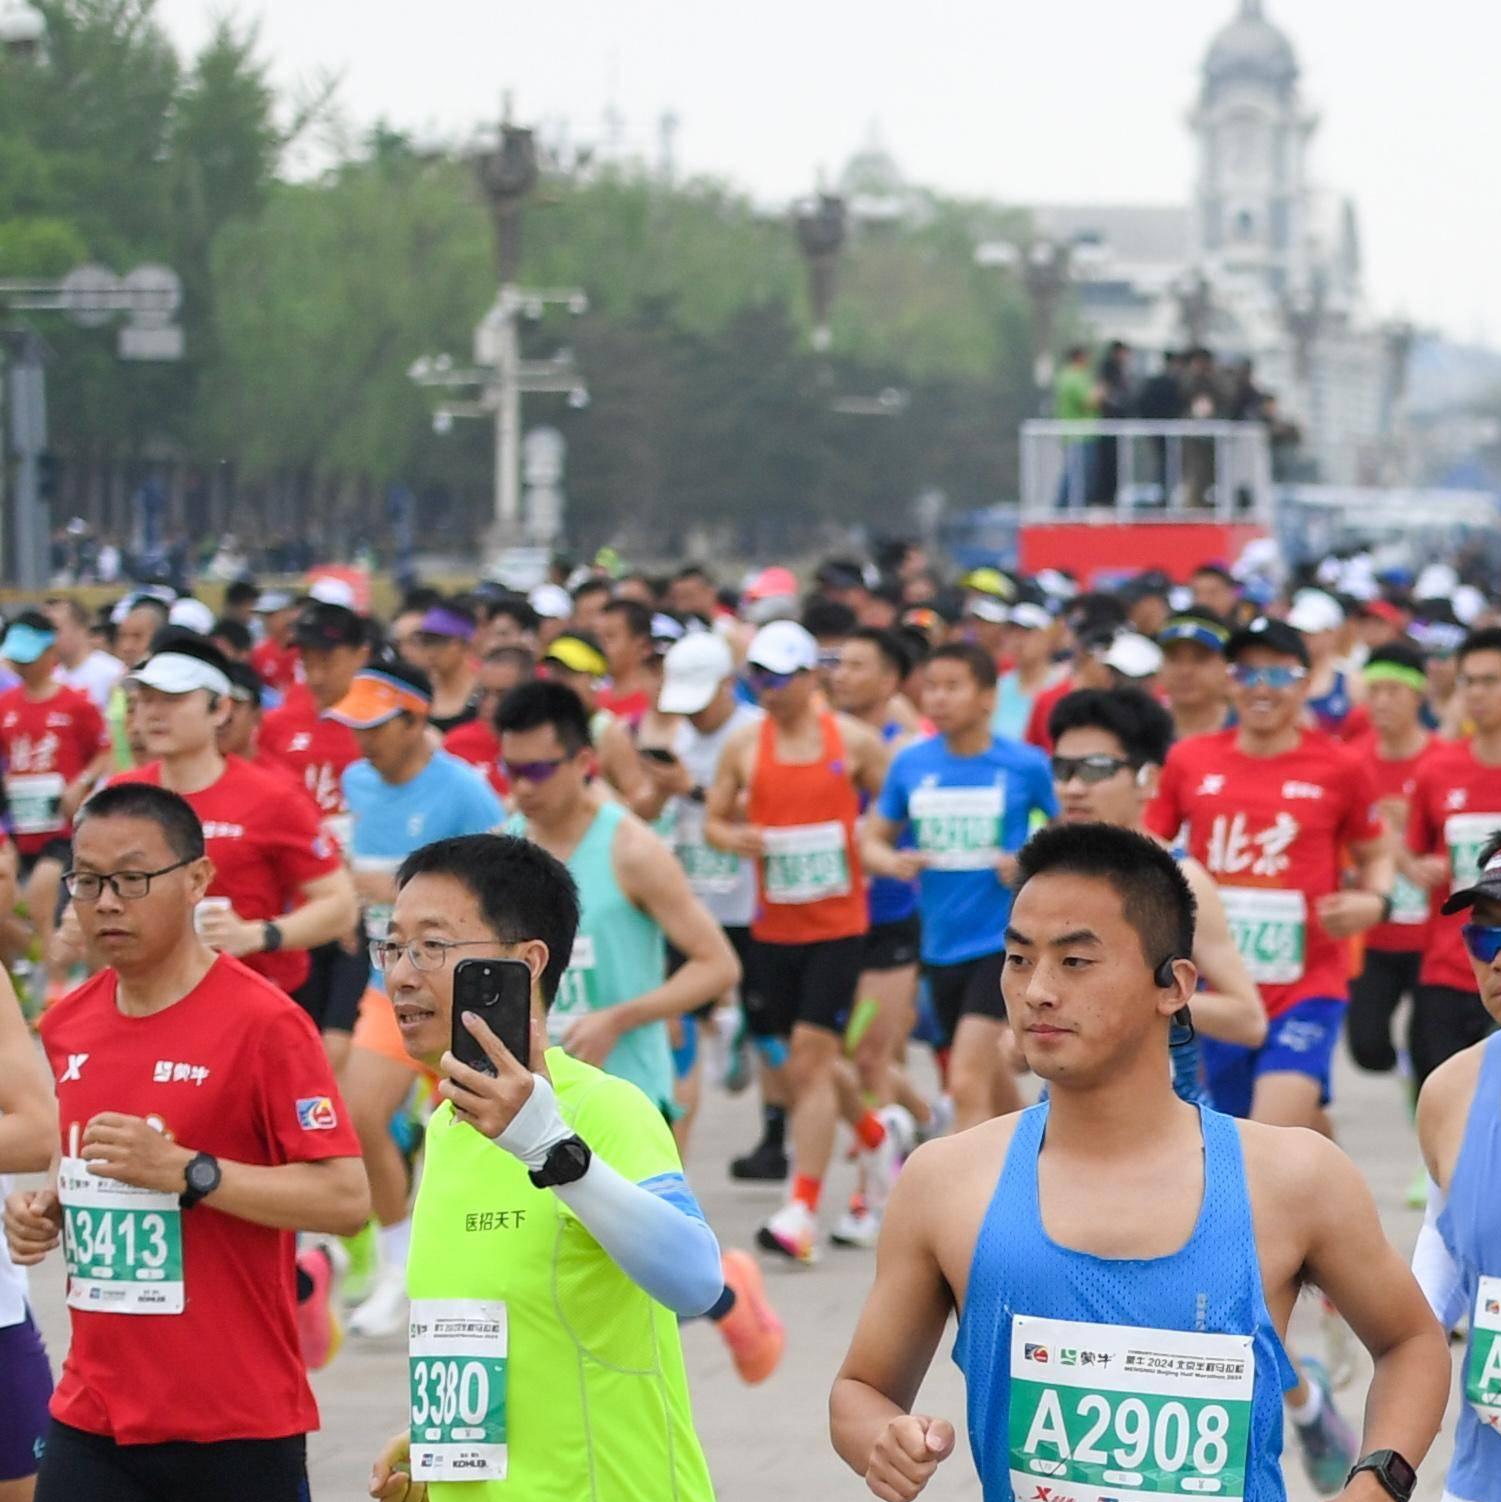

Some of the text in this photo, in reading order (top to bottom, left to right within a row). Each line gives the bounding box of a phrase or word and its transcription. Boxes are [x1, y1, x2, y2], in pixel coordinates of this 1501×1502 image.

[64, 1208, 169, 1268] A3413
[465, 1209, 527, 1232] 医招天下
[412, 1361, 490, 1426] 3380
[1147, 1358, 1174, 1369] 2024
[1023, 1388, 1230, 1475] A2908
